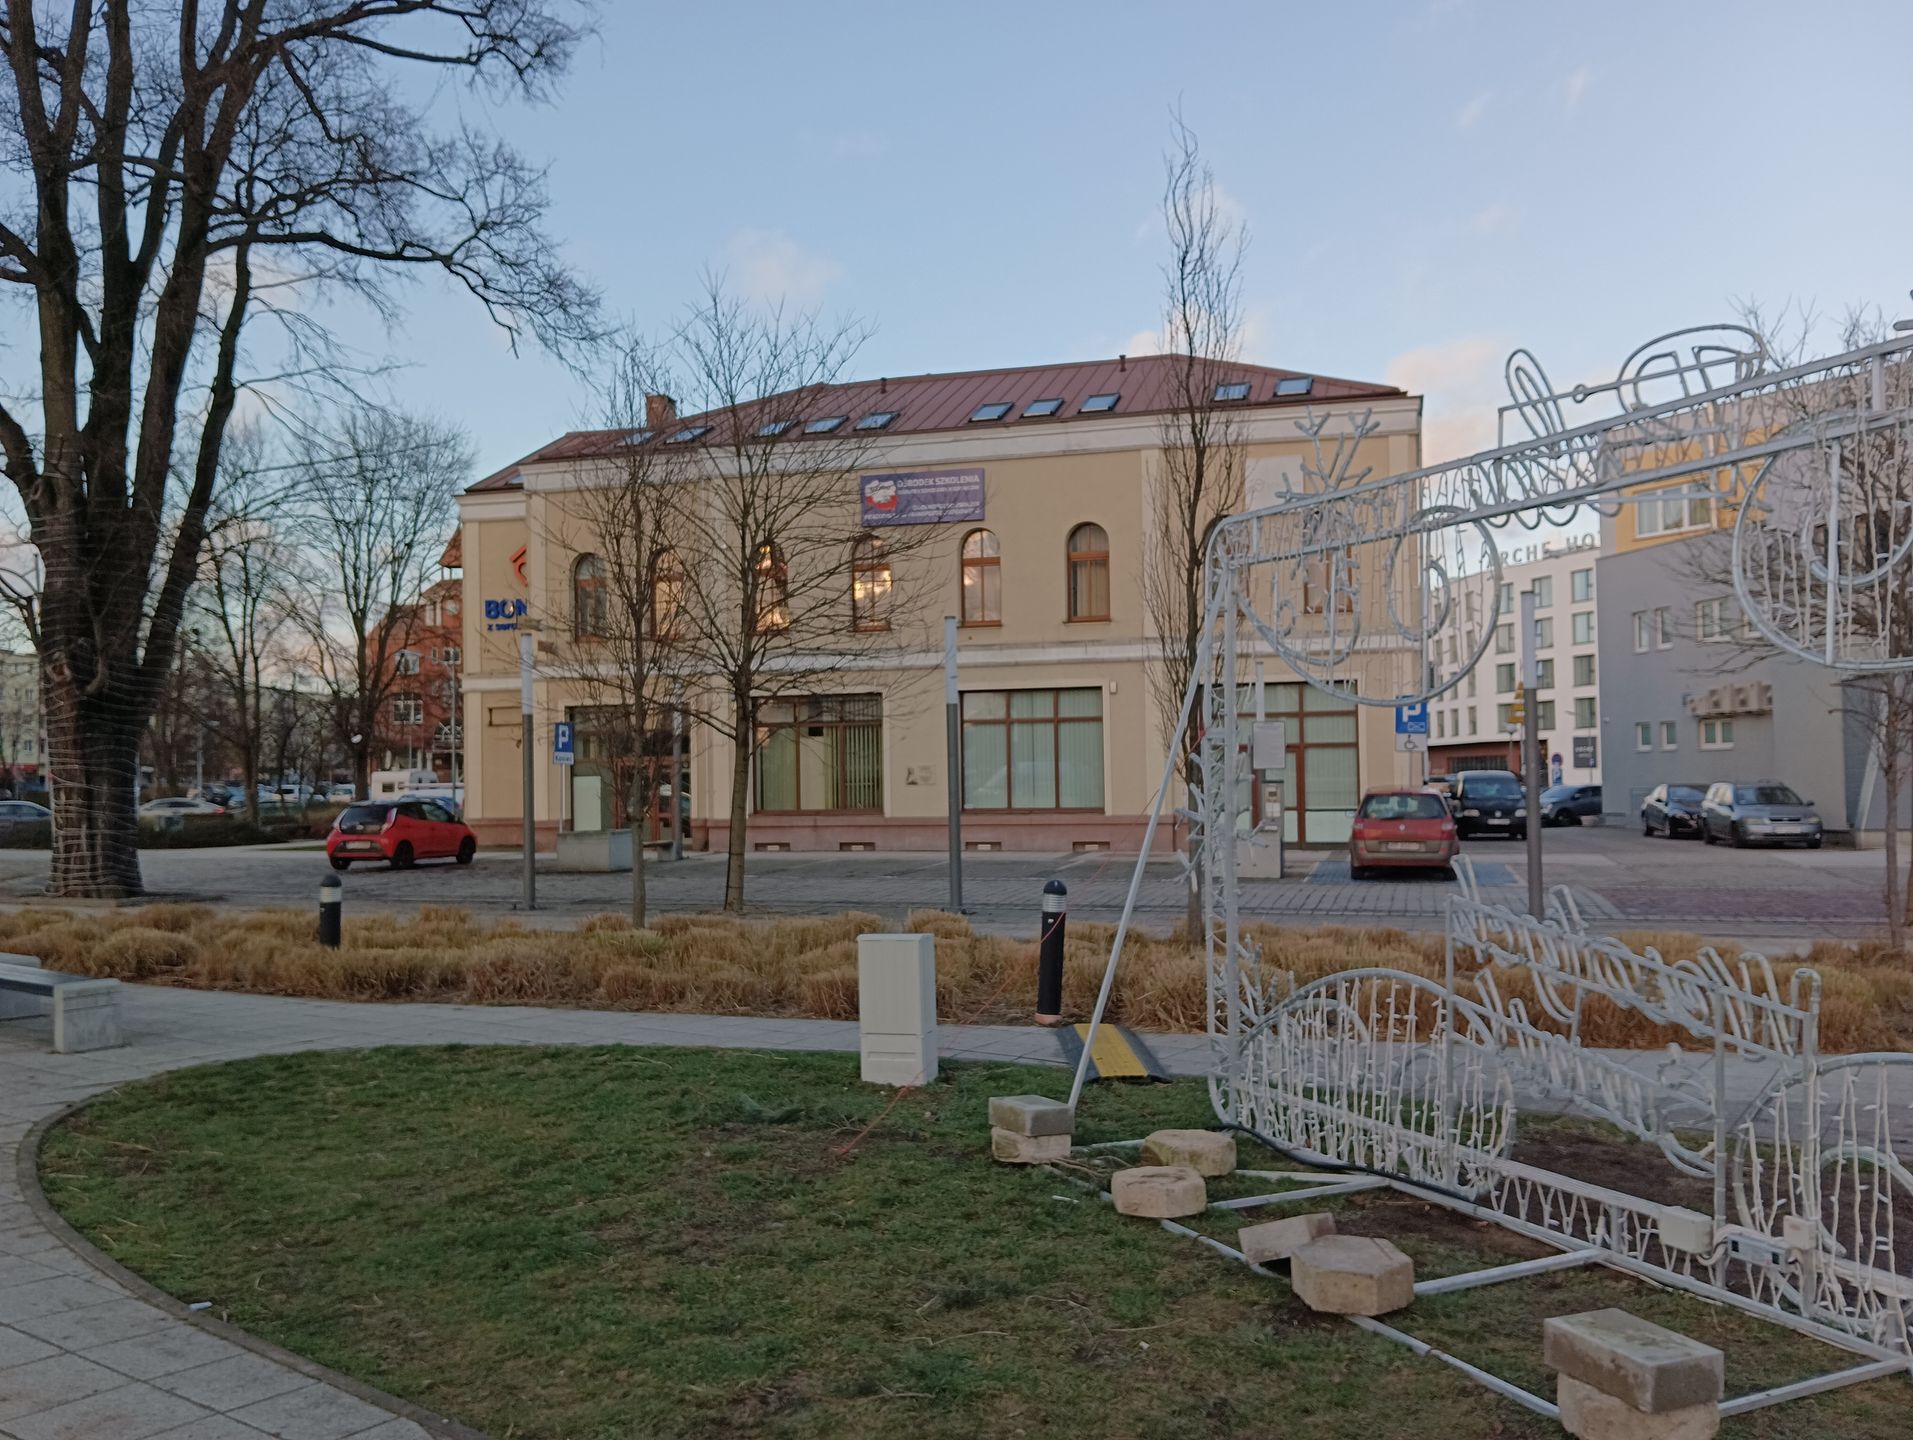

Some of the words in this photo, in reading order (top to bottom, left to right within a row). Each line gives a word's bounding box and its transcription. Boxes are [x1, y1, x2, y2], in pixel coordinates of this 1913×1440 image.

[1488, 541, 1550, 567] RCHE
[1566, 532, 1599, 552] HO
[1402, 701, 1422, 723] P
[558, 724, 569, 749] P
